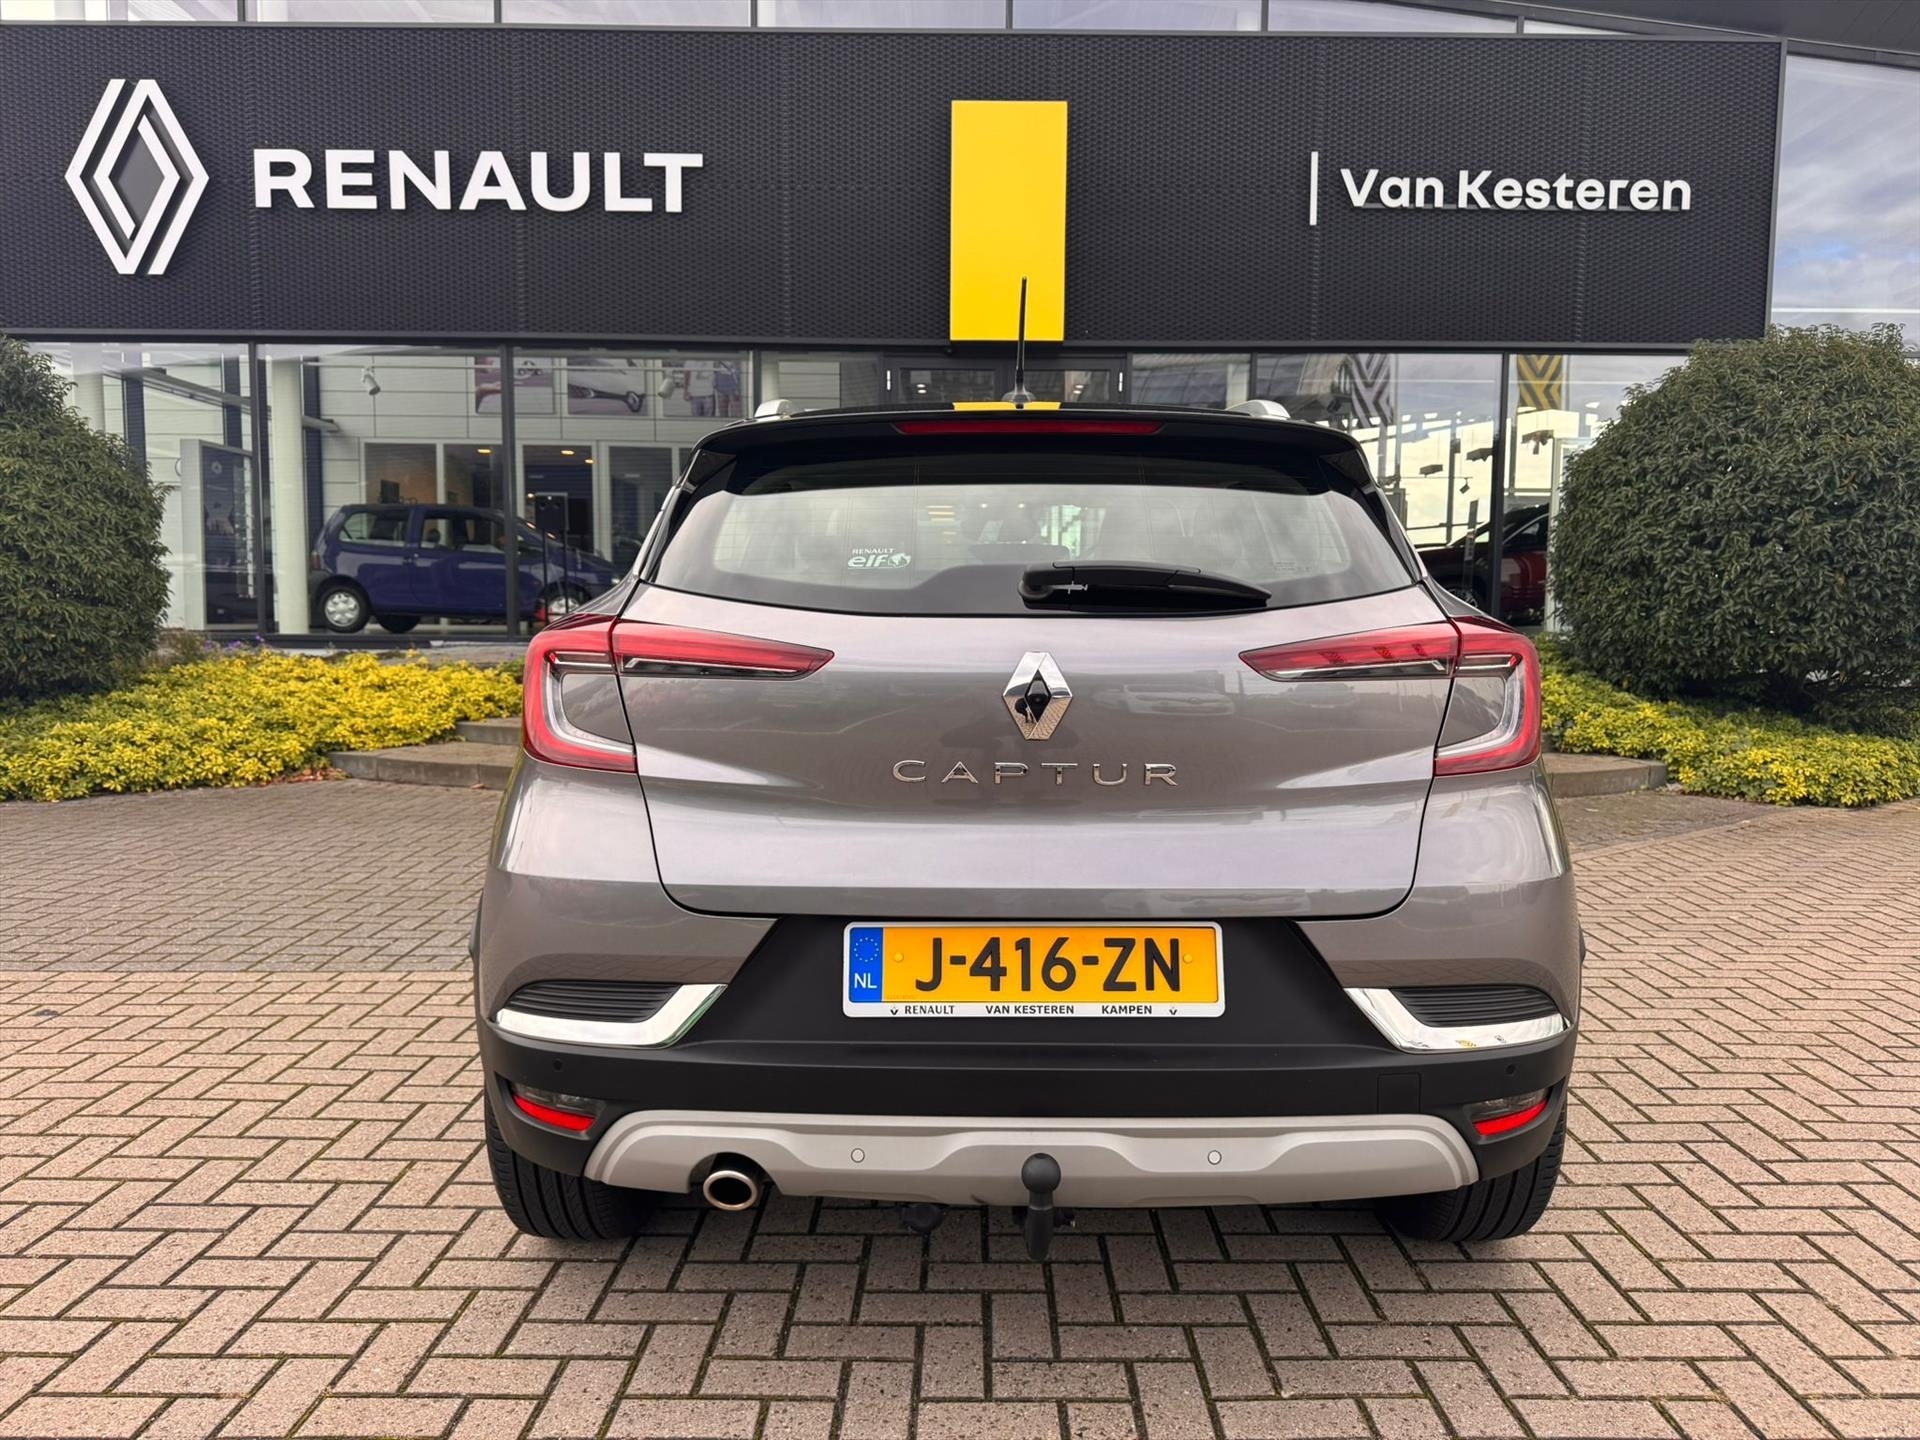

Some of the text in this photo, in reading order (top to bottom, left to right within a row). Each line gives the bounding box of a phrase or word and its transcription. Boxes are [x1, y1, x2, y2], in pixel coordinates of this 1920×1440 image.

[253, 148, 703, 213] RENAULT
[1340, 168, 1692, 211] Van Kesteren
[847, 554, 888, 567] elf
[892, 759, 1178, 786] CAPTUR
[915, 937, 1180, 992] J-416-ZN
[854, 973, 877, 989] NL
[904, 1005, 1153, 1015] RENAULT VAN KESTEREN KAMPEN
